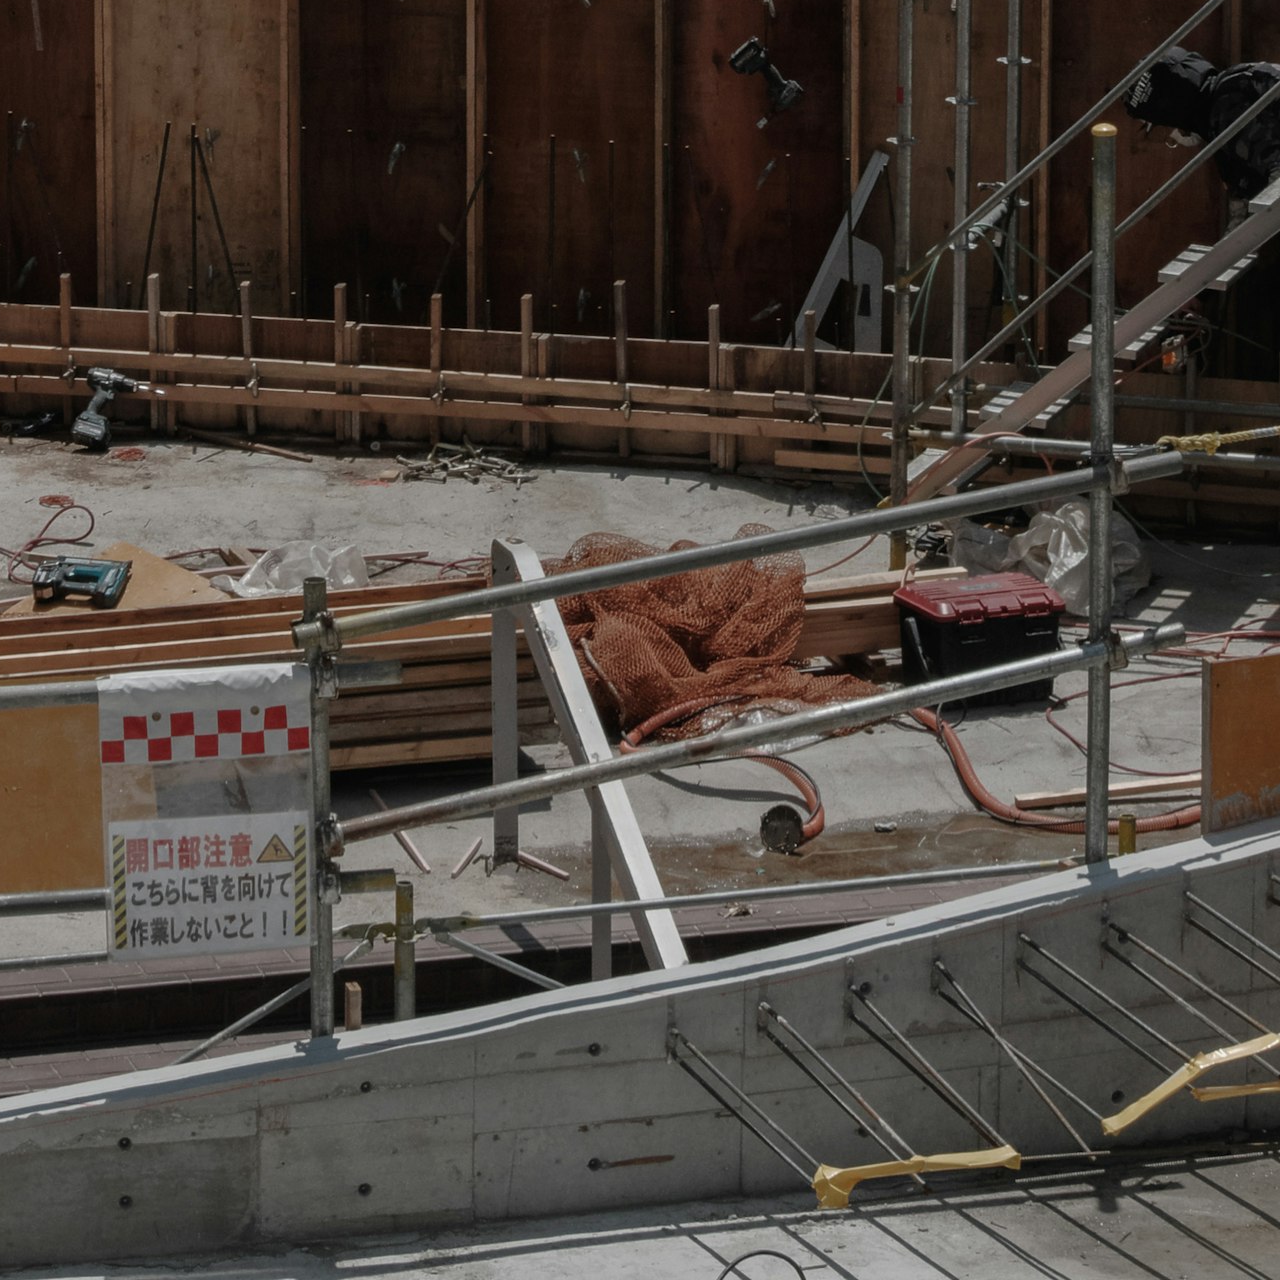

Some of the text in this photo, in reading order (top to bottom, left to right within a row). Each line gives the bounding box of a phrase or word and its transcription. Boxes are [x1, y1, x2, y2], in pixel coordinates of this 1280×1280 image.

[126, 832, 254, 875] 開口部注意
[131, 871, 293, 907] こちらに背を向けて
